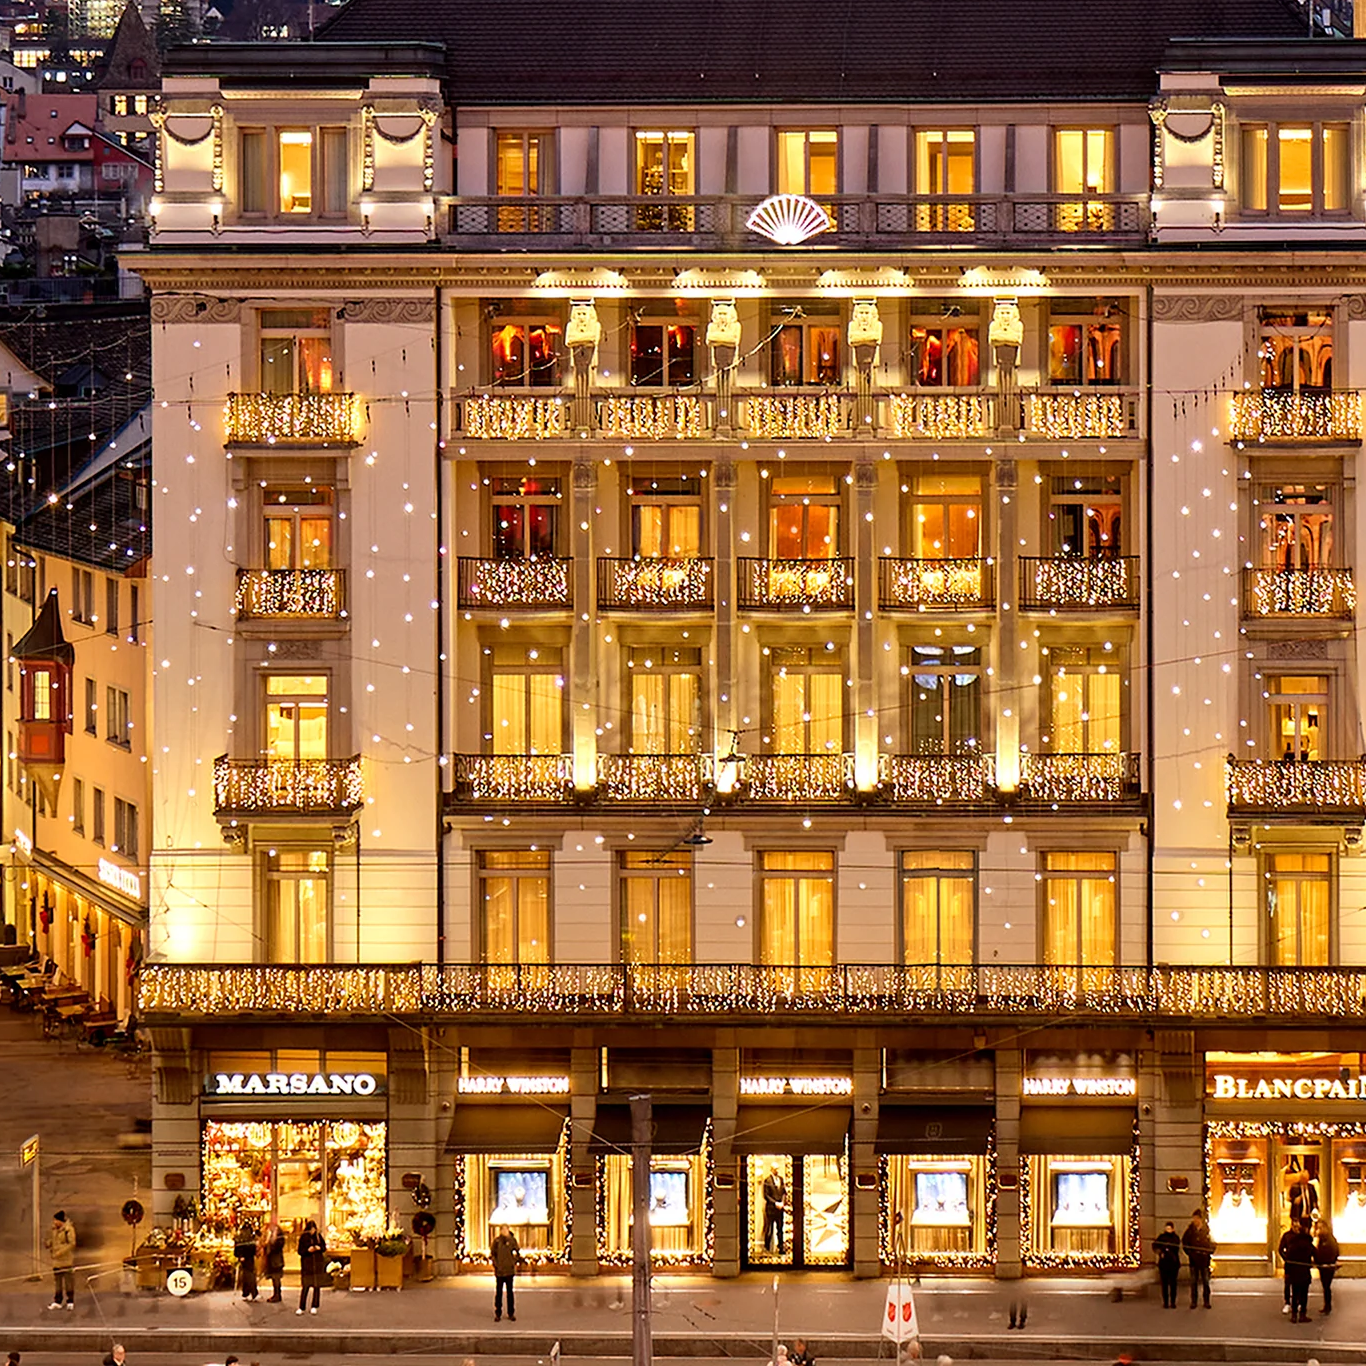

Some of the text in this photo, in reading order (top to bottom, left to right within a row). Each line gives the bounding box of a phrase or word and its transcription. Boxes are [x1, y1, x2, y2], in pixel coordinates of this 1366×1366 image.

[215, 1074, 377, 1095] MARSANO
[458, 1077, 569, 1093] HARRY WINSTON
[740, 1077, 852, 1094] HARRY WINSTON
[1023, 1078, 1136, 1095] HARRY WINSTON
[173, 1277, 187, 1289] 15
